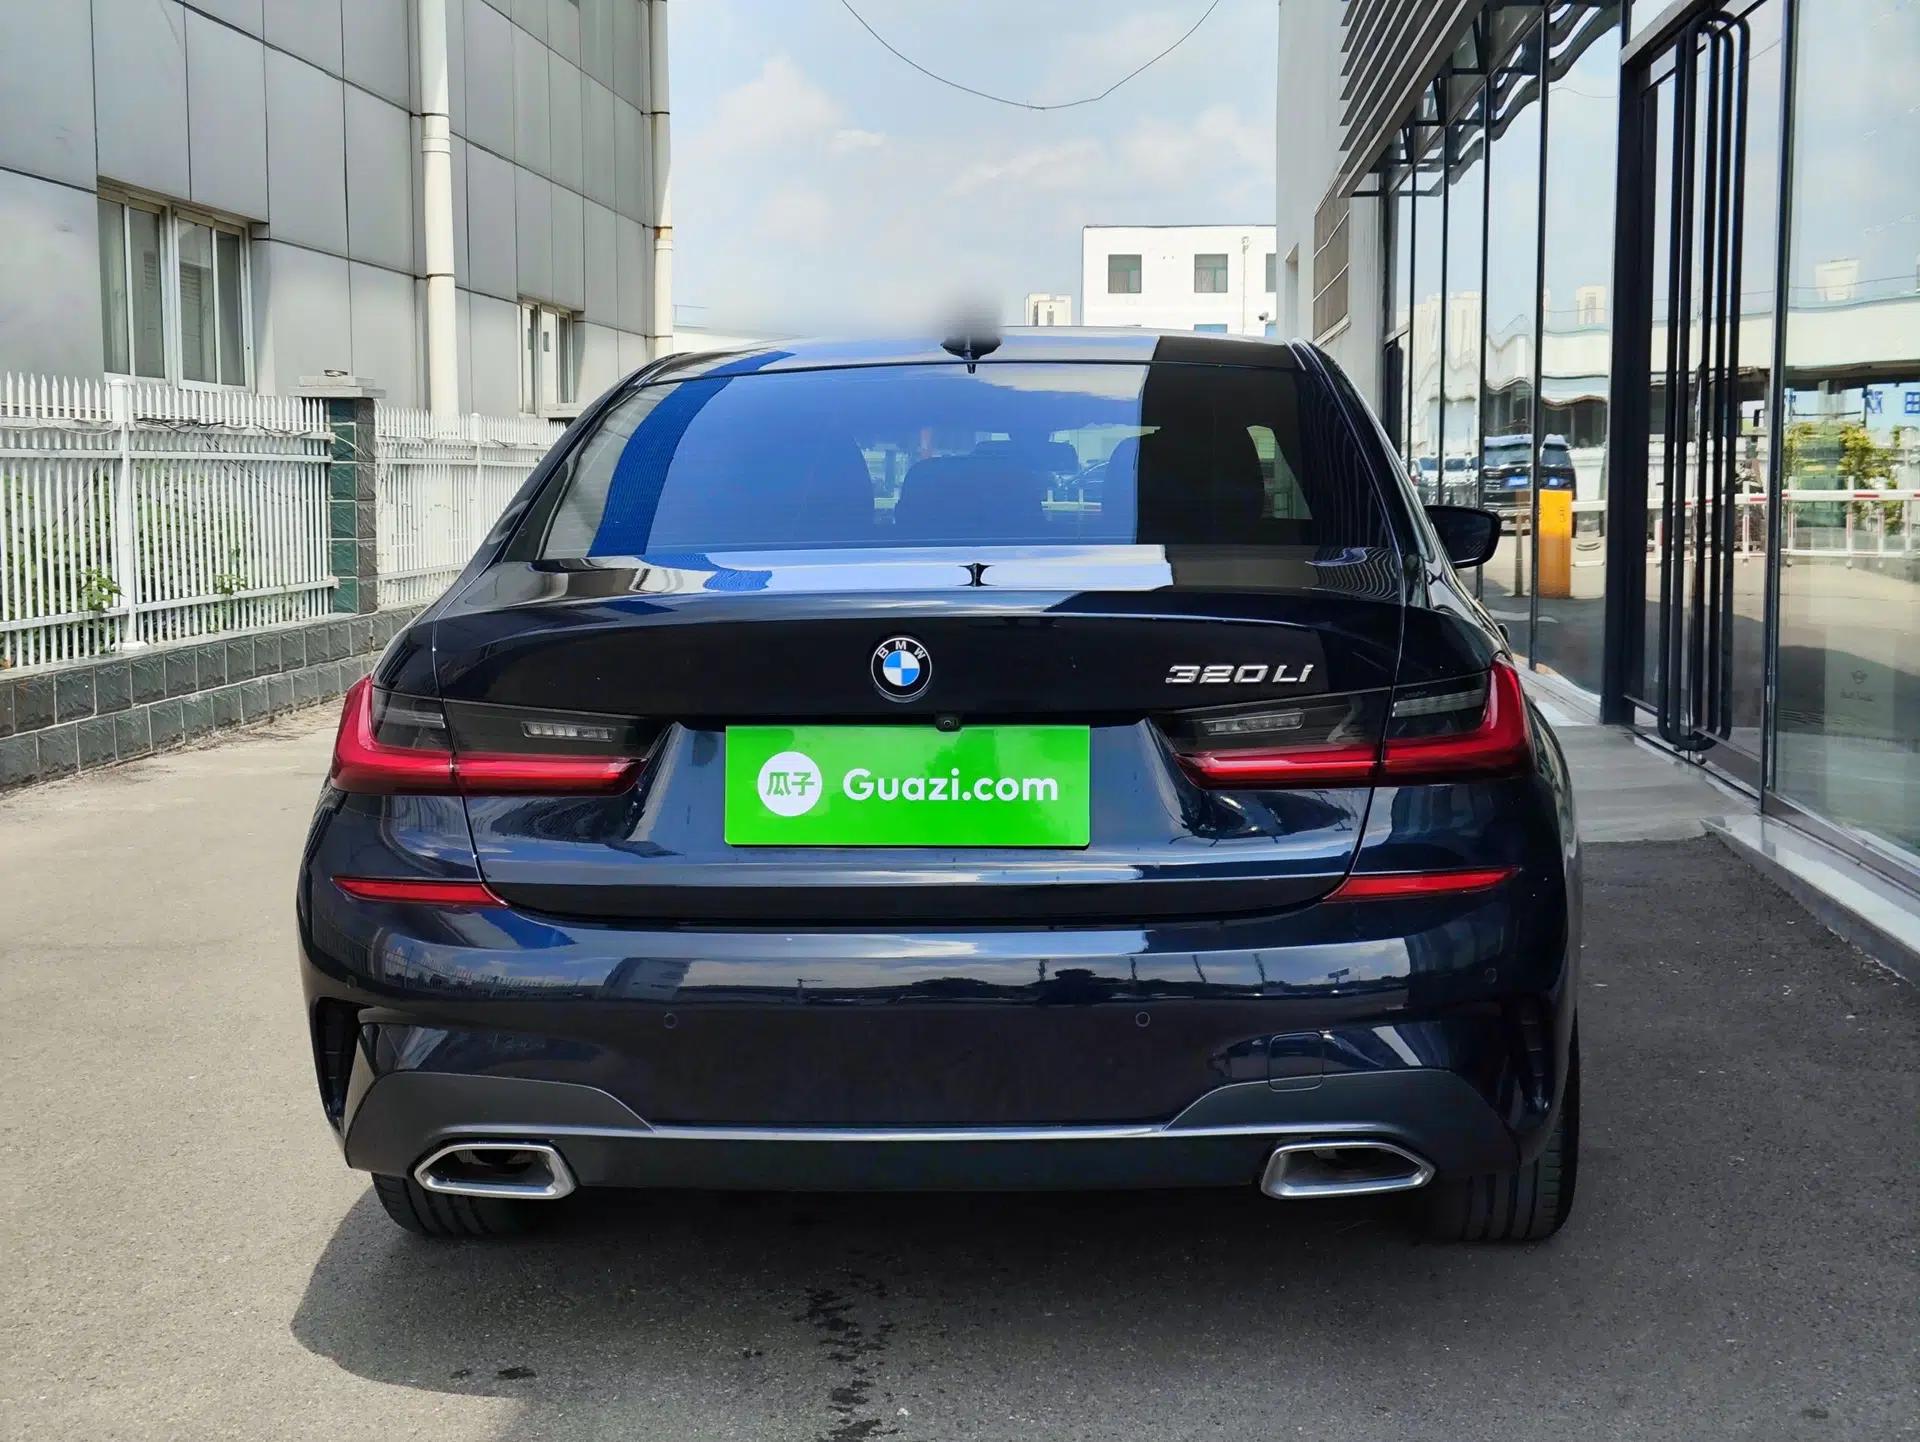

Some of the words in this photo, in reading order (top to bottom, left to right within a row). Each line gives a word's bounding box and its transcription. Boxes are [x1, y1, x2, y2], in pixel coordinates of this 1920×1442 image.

[877, 640, 926, 660] BMW
[766, 771, 816, 798] 瓜子
[842, 767, 1058, 802] Guazi.com
